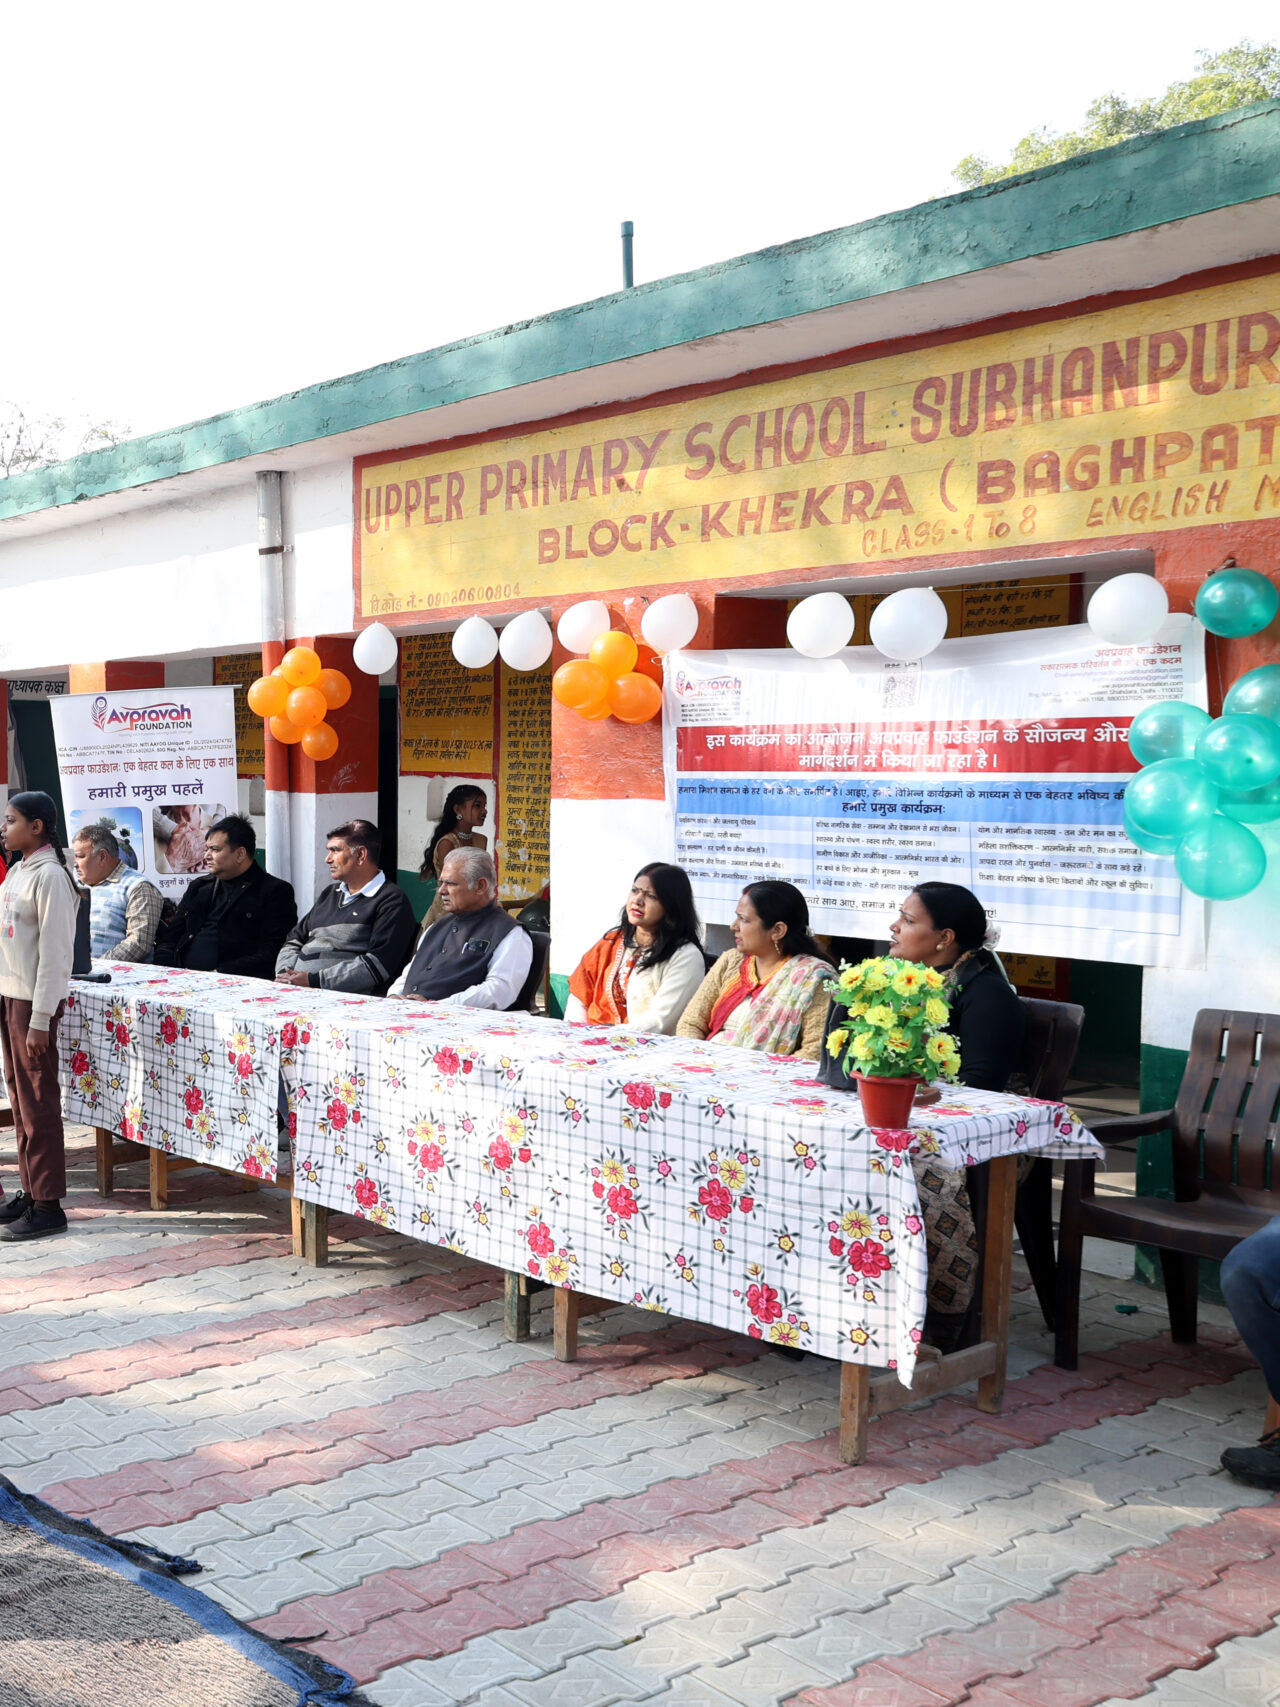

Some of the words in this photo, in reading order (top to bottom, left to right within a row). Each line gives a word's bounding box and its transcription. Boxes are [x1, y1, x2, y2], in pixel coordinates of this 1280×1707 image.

[364, 471, 465, 534] UPPER
[479, 429, 670, 516] PRIMARY
[684, 391, 886, 480] SCHOOL
[910, 312, 1280, 443] SUBHANPUR
[1019, 504, 1037, 535] 8
[1086, 479, 1231, 528] ENGLISH
[538, 474, 915, 565] BLOCK-KHEKRA
[44, 680, 67, 695] कक्ष
[107, 704, 191, 730] Avpravah
[134, 720, 192, 731] FOUNDATION
[706, 734, 726, 750] इस
[729, 728, 781, 746] कार्यक्रम
[784, 733, 802, 746] का
[807, 727, 864, 745] आयोजन
[869, 731, 929, 746] अवप्रवाह
[933, 726, 998, 745] फाउंडेशन
[1003, 725, 1019, 743] के
[1023, 722, 1087, 743] सौजन्य
[1093, 722, 1129, 743] और
[123, 761, 135, 772] एक
[138, 757, 158, 772] बेहतर
[160, 760, 173, 770] कल
[176, 756, 183, 769] के
[186, 755, 200, 769] लिए
[203, 758, 216, 769] एक
[218, 757, 234, 767] साथ
[798, 749, 860, 768] मार्गदर्शन
[864, 749, 877, 767] में
[882, 749, 916, 767] किया
[922, 754, 942, 768] जा
[948, 753, 971, 768] रहा
[88, 782, 126, 800] हमारी
[131, 784, 167, 801] प्रमुख
[172, 779, 203, 796] पहलें
[678, 786, 697, 794] हमारा
[720, 786, 740, 794] समाज
[742, 785, 749, 794] के
[751, 786, 760, 795] हर
[845, 788, 870, 798] आइए,
[927, 787, 963, 799] कार्यक्रमों
[966, 788, 975, 799] के
[978, 791, 1009, 800] माध्यम
[1014, 788, 1021, 800] से
[1025, 791, 1042, 800] एक
[1045, 788, 1073, 800] बेहतर
[1077, 789, 1109, 800] भविष्य
[842, 799, 866, 812] हमारे
[871, 803, 897, 816] प्रमुख
[822, 897, 837, 906] साथ
[861, 900, 885, 909] समाज
